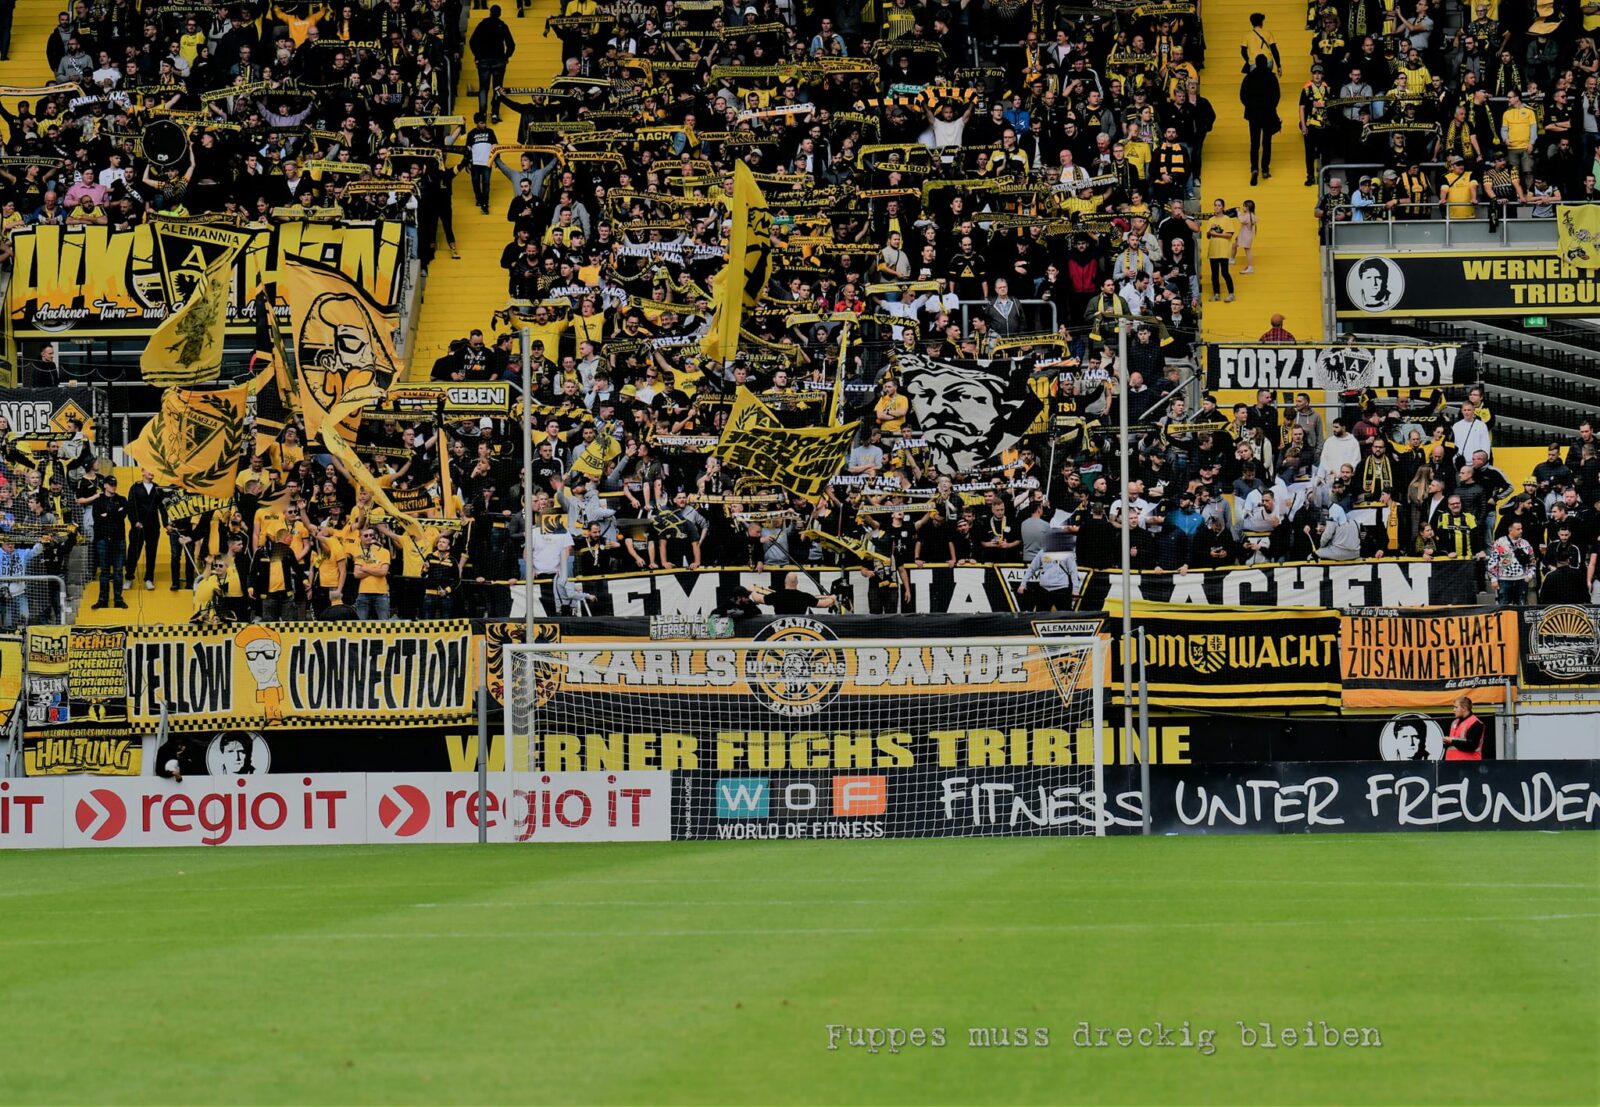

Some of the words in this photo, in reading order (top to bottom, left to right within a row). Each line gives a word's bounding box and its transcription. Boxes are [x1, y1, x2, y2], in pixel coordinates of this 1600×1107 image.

[904, 165, 928, 173] 1900
[161, 223, 240, 247] ALEMANNIA
[181, 245, 207, 270] A
[1462, 258, 1575, 281] WERNER
[1510, 279, 1600, 305] TRIBÜ
[36, 300, 91, 320] Aachener
[94, 299, 138, 321] Turn-
[143, 302, 166, 320] und
[1219, 348, 1319, 389] FORZA
[1371, 348, 1458, 389] ATSV
[447, 388, 506, 405] GEBEN!
[1106, 562, 1433, 610] AACHEN
[650, 614, 708, 625] LEGENDEN
[651, 623, 692, 638] STERBEN
[771, 617, 824, 633] KARLS
[1040, 623, 1096, 633] ALEMANNIA
[1350, 612, 1503, 649] FREUNDSCHAFT
[70, 633, 124, 649] FREIHEIT
[1229, 633, 1337, 670] WACHT
[69, 658, 124, 668] SICHERHEIT
[288, 635, 469, 711] CONNECTION
[565, 648, 738, 687] KARLS
[854, 646, 1029, 687] BANDE
[1347, 644, 1507, 679] ZUSAMMENHALT
[1544, 656, 1588, 672] TIVOLI
[31, 678, 65, 694] NEIN
[126, 639, 234, 716] YELLOW
[1445, 679, 1457, 689] die
[81, 687, 124, 696] VERLIEREN
[28, 705, 47, 722] ZU
[769, 700, 823, 716] BANDE
[36, 738, 132, 770] HALTUNG
[445, 732, 701, 773] WERNER
[716, 731, 915, 770] FUCHS
[928, 720, 1192, 770] TRIBÜNE
[1, 781, 44, 834] iT
[142, 778, 288, 846] regio
[303, 776, 348, 830] iT
[445, 775, 592, 843] regio
[607, 773, 653, 827] iT
[941, 777, 1152, 826] FITNESS
[1174, 776, 1345, 826] UNTER
[717, 821, 781, 840] WORLD
[785, 821, 808, 840] OF
[812, 820, 884, 839] FITNESS
